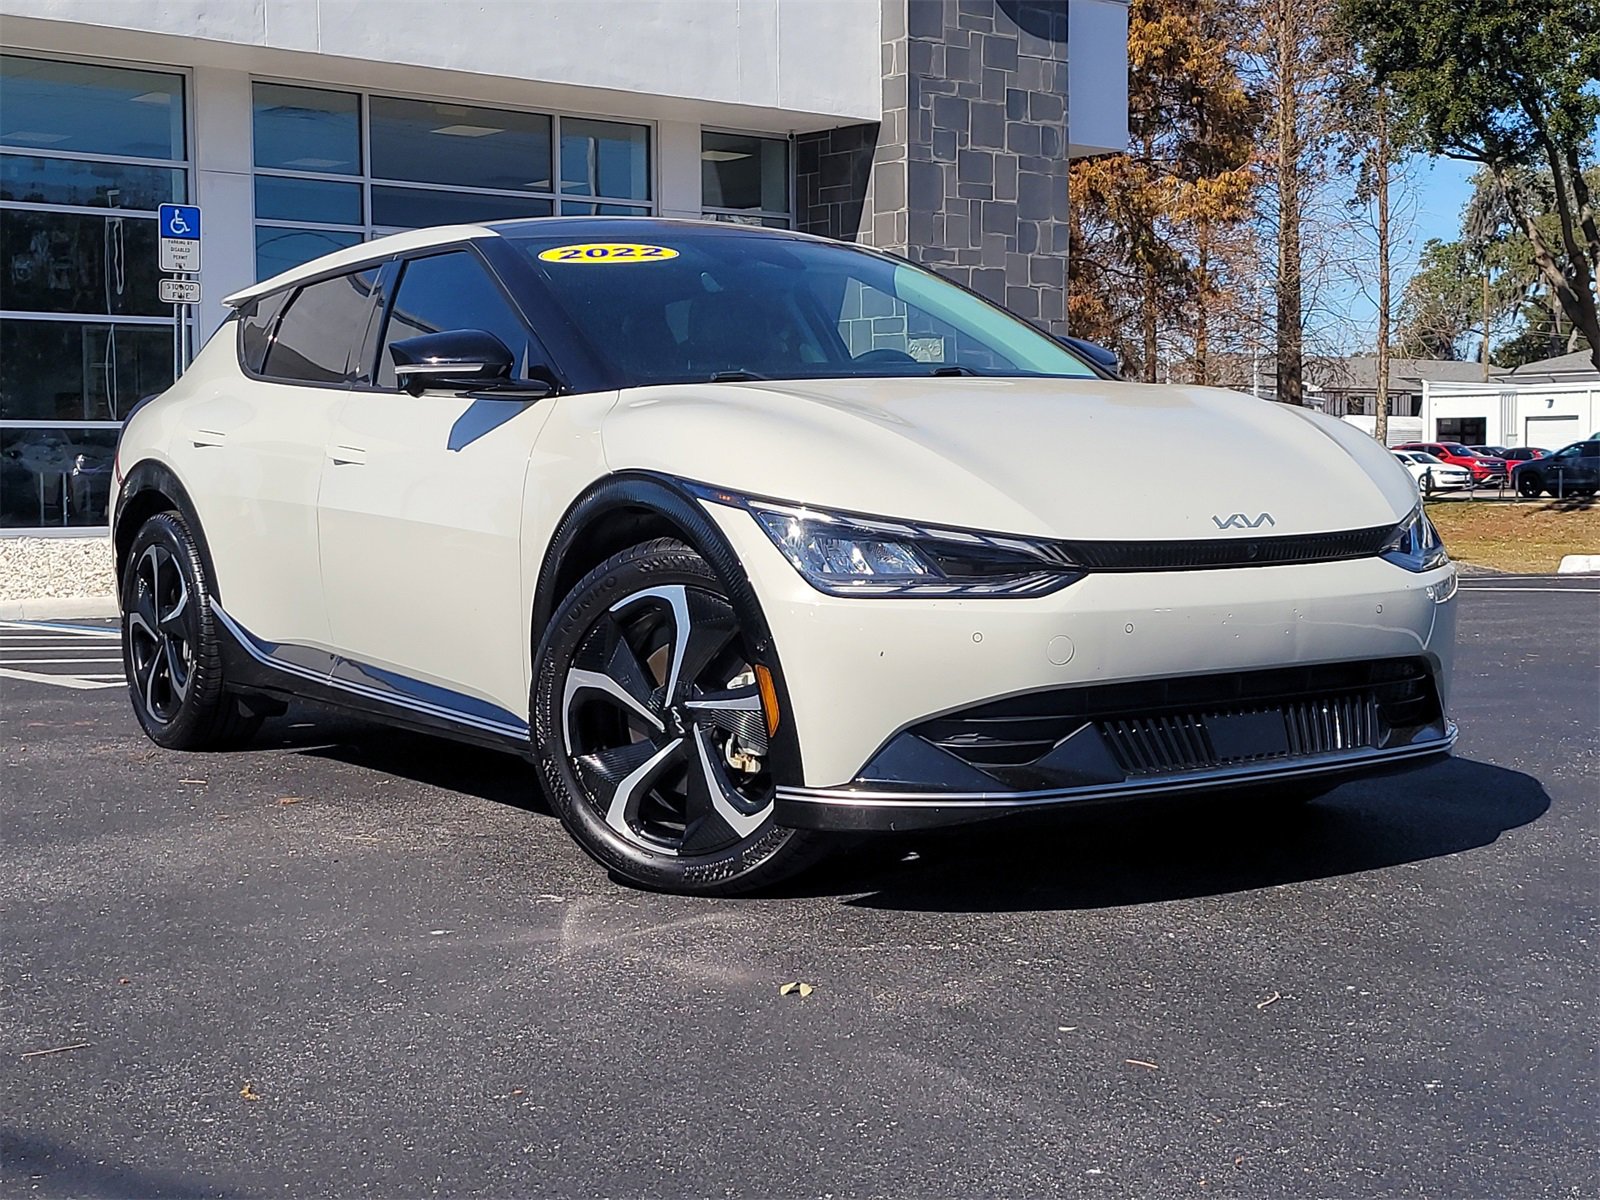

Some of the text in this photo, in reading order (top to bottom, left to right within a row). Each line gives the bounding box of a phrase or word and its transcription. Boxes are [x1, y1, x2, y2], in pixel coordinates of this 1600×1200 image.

[558, 247, 664, 260] 2022
[1211, 512, 1276, 530] KIA
[560, 575, 618, 635] KUMHO
